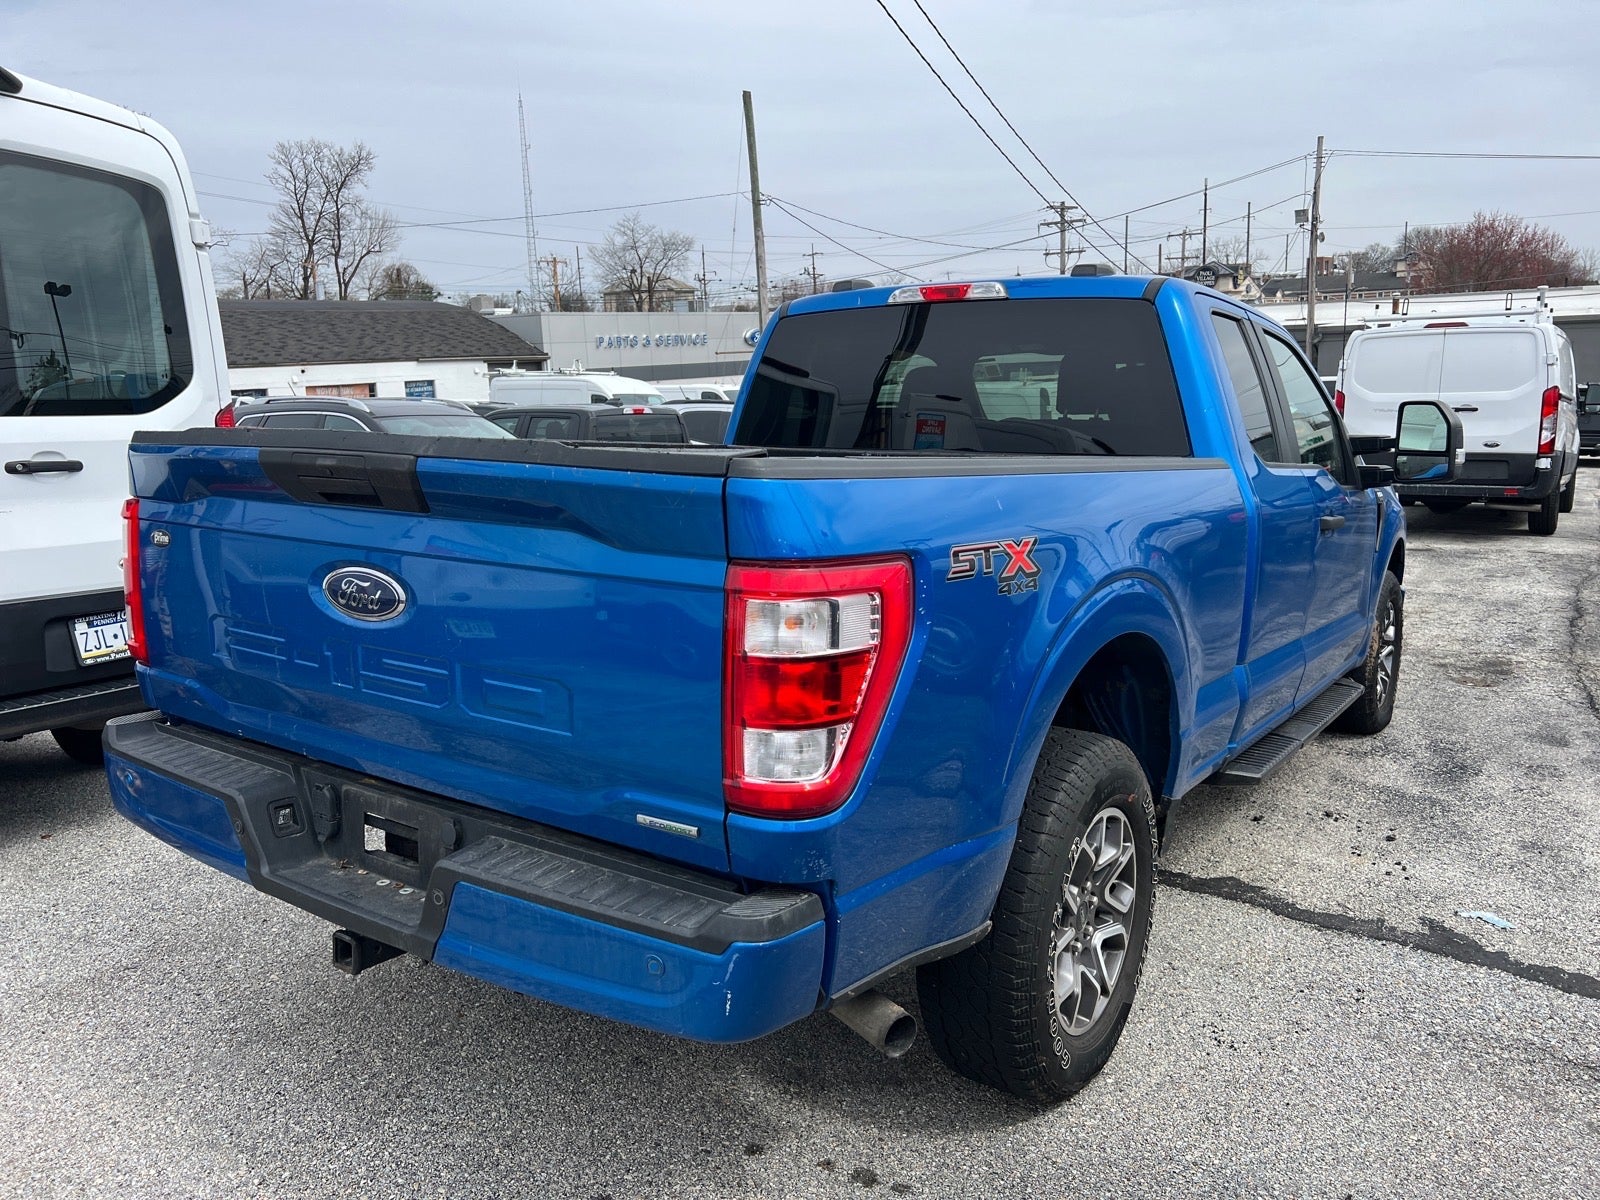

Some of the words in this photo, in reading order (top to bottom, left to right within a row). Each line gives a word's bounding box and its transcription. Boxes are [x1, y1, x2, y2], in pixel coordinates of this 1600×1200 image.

[596, 334, 639, 349] PARTS
[642, 334, 652, 348] &
[654, 332, 709, 348] SERVICE
[946, 534, 1041, 585] STX
[336, 576, 381, 611] Ford
[75, 612, 116, 623] CELEBRATING
[212, 613, 574, 736] F-150
